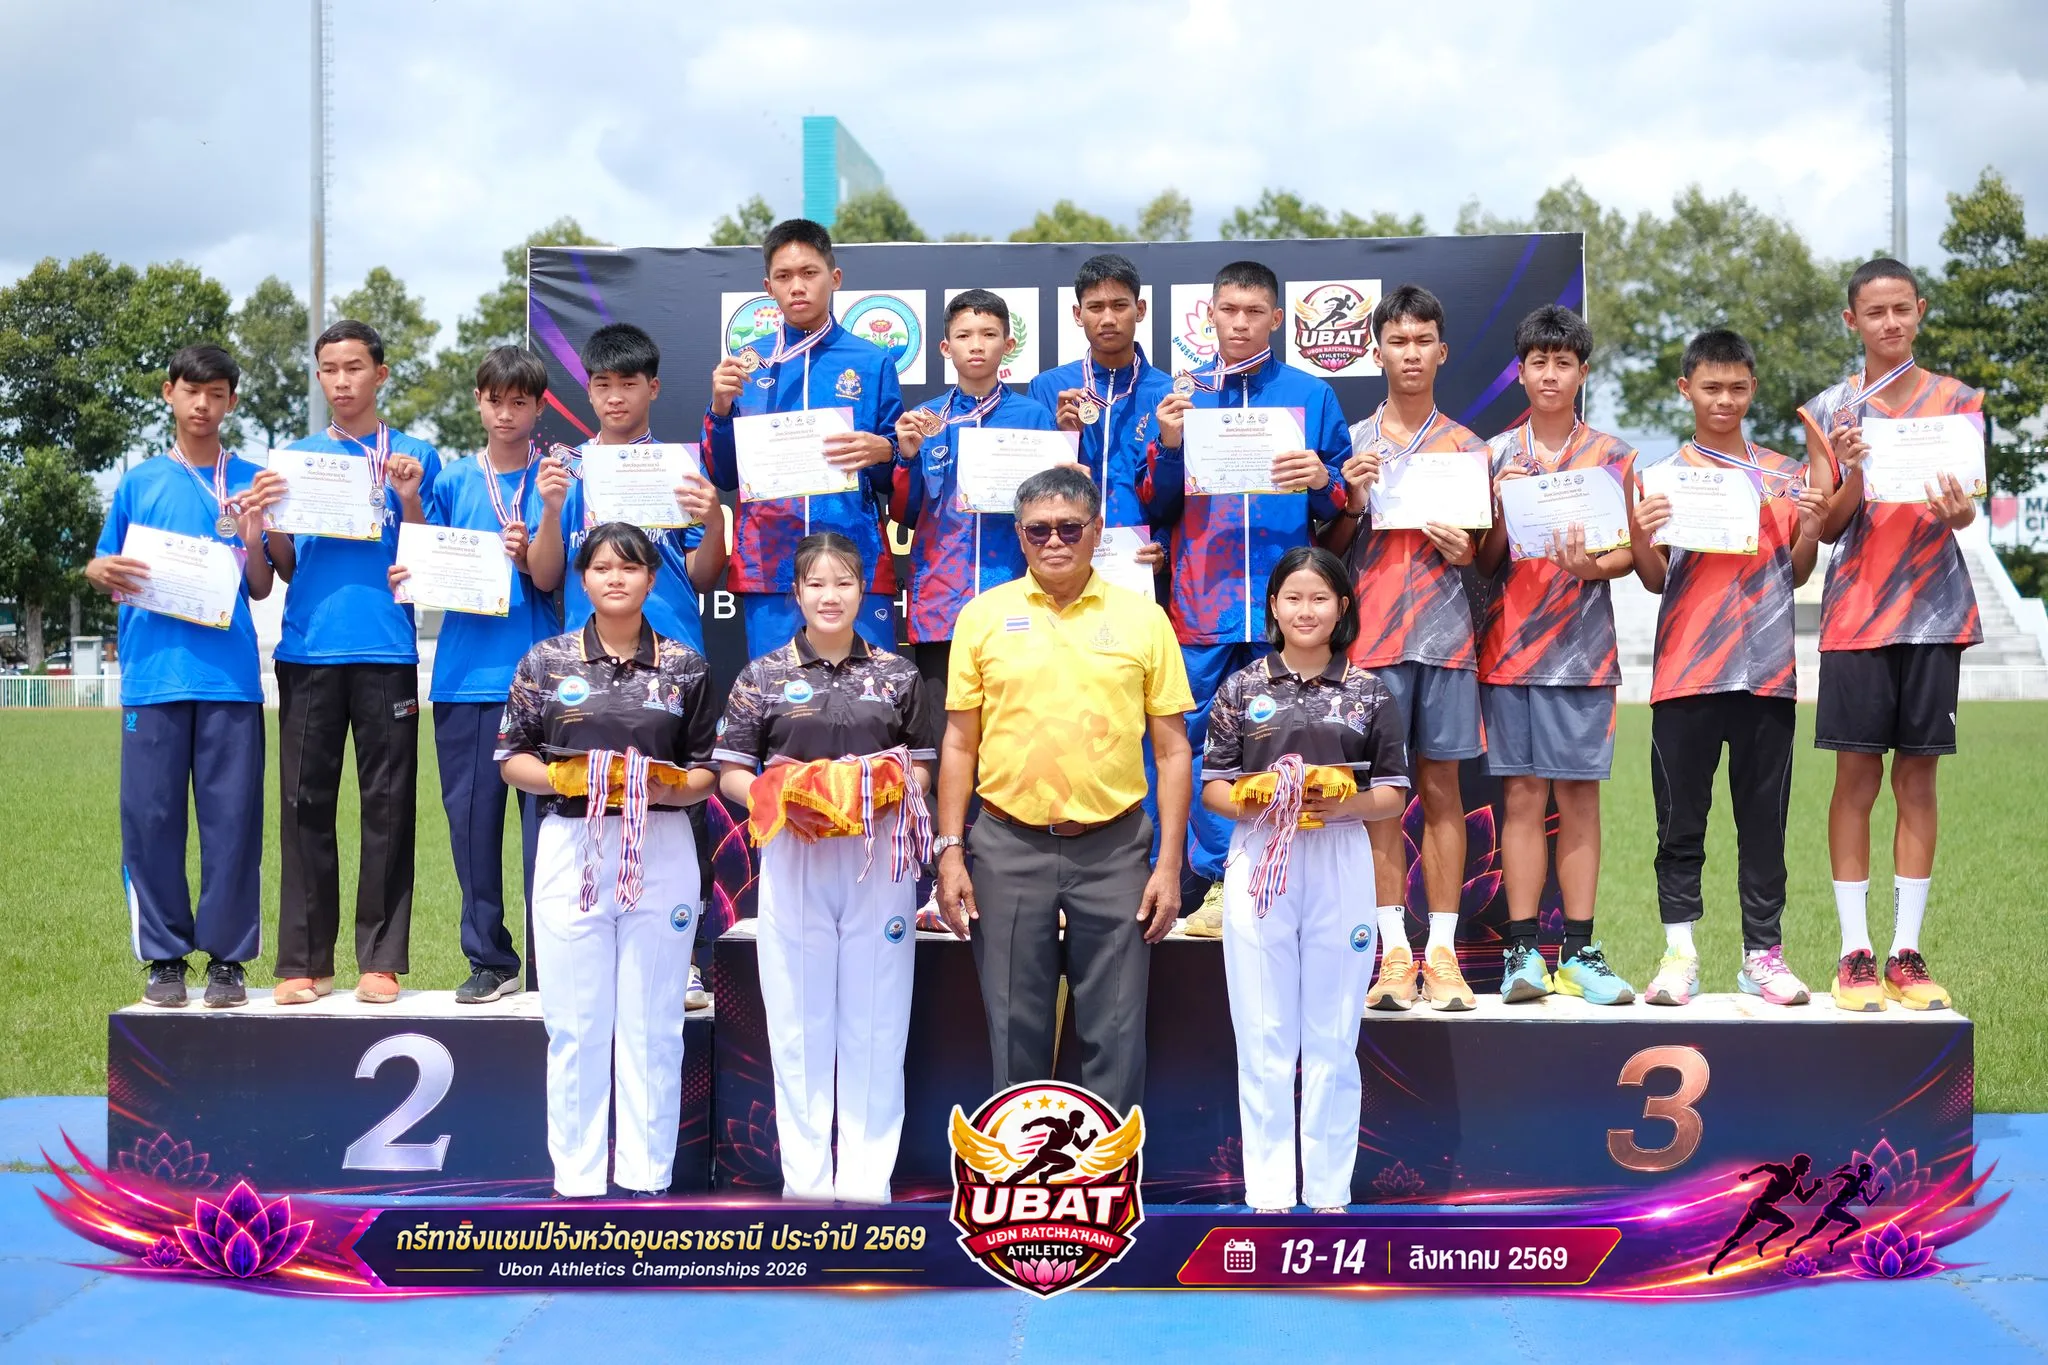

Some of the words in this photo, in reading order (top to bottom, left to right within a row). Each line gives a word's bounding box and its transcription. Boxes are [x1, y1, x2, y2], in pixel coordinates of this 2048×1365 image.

[1301, 329, 1366, 347] UBAT
[342, 1033, 455, 1171] 2
[1607, 1045, 1710, 1172] 3
